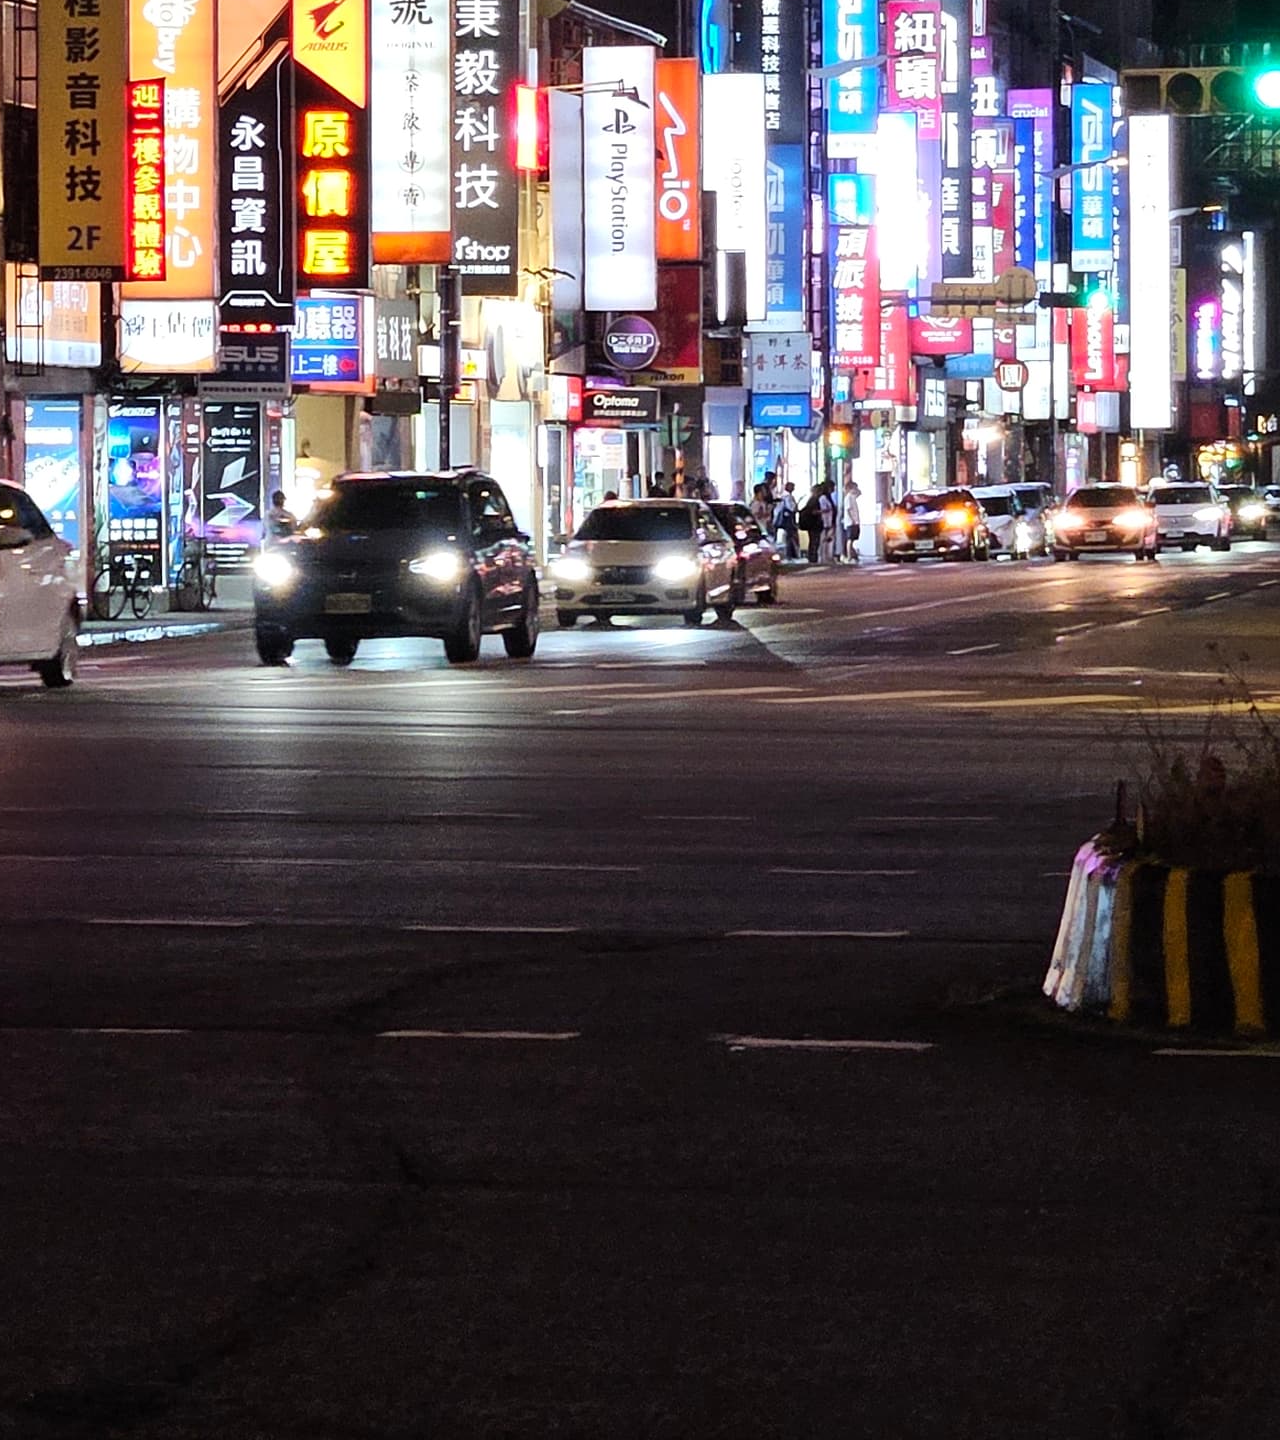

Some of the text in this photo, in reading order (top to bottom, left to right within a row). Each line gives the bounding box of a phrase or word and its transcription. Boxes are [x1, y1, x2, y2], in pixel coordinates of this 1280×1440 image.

[300, 42, 349, 51] AORUS
[894, 11, 937, 100] 紐頓
[165, 87, 202, 269] 購物中心
[230, 115, 268, 276] 永昌資訊
[302, 109, 351, 275] 原價屋
[605, 143, 628, 253] PlayStation
[66, 225, 101, 251] 2F
[219, 345, 281, 363] SUS
[291, 354, 339, 377] 上二樓
[593, 393, 640, 410] Optoma
[760, 403, 802, 417] ASUS
